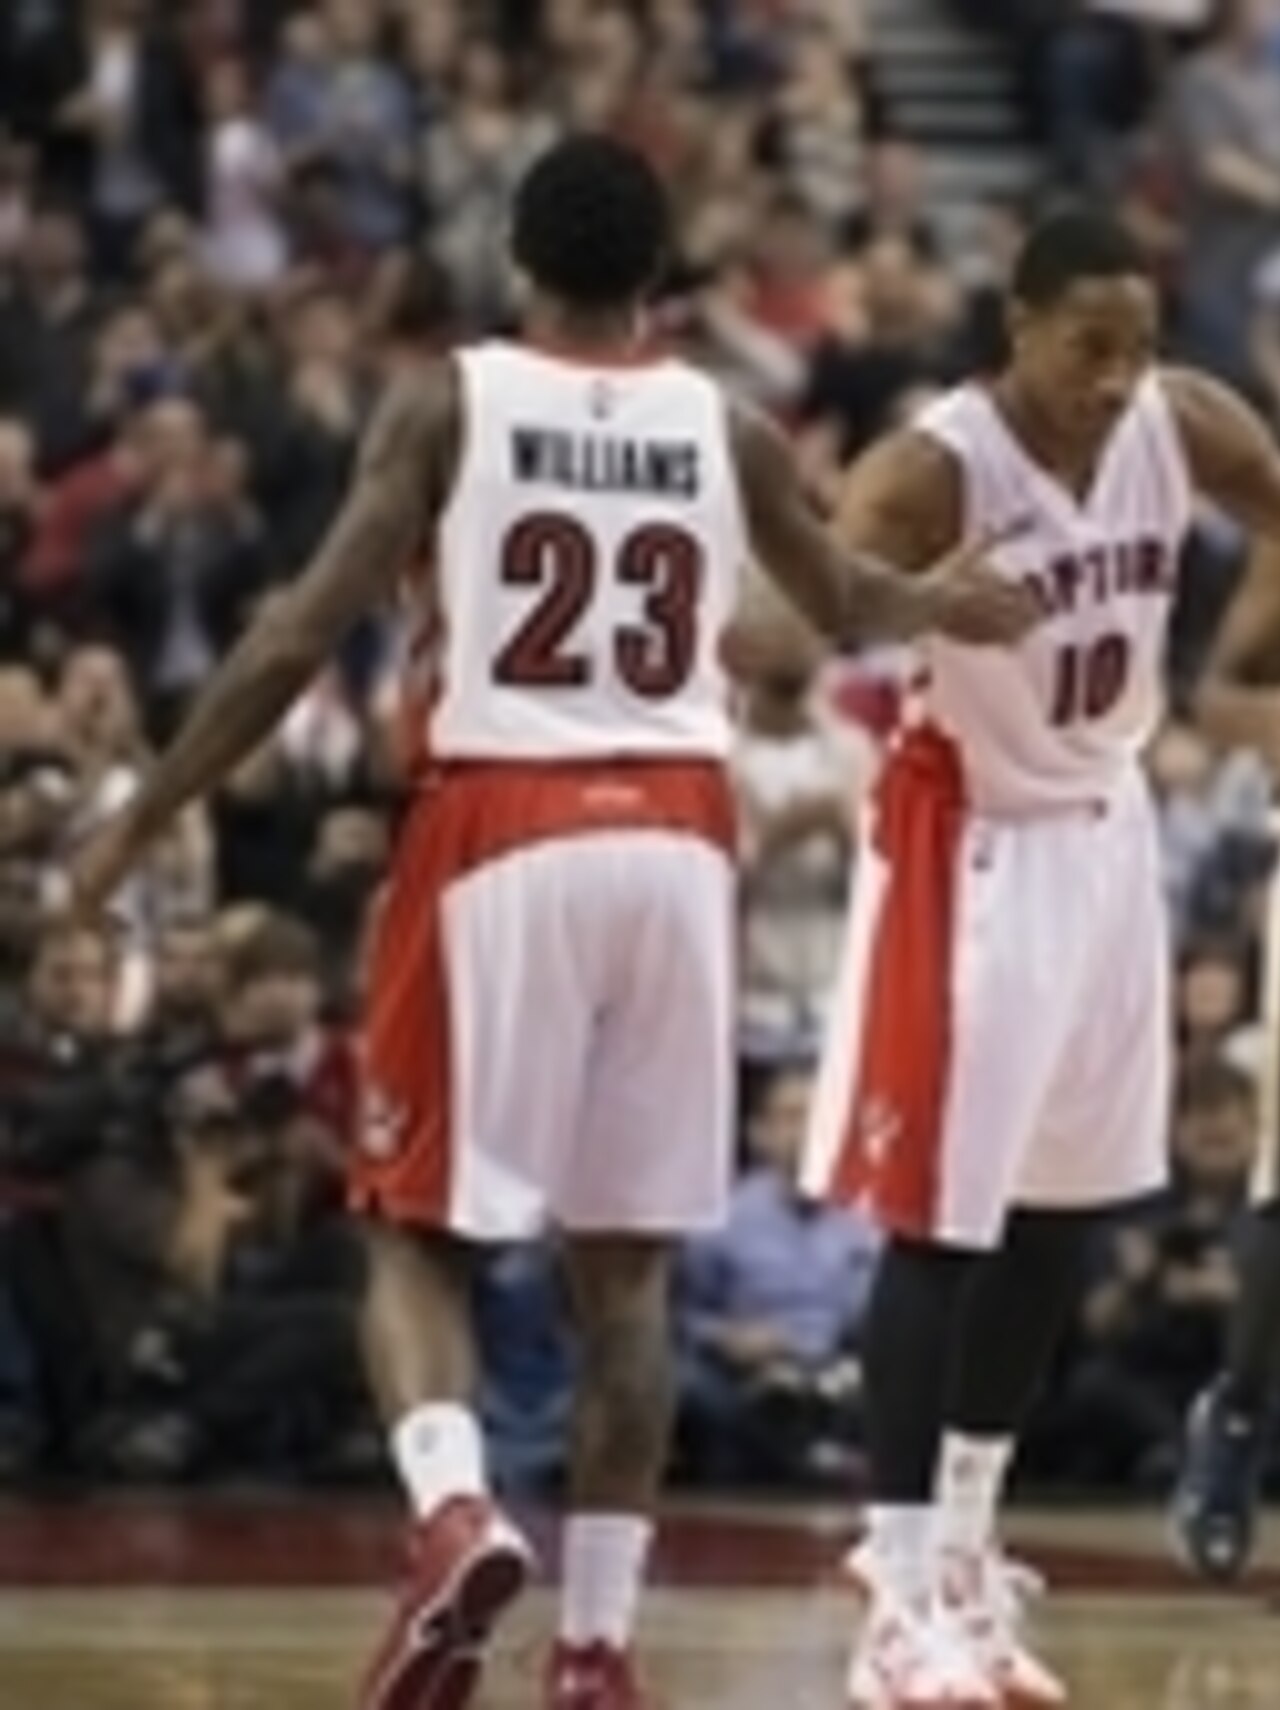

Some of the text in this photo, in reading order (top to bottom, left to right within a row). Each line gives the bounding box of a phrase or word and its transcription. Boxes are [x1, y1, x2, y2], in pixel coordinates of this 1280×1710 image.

[511, 427, 701, 501] WILLIAMS
[492, 509, 706, 701] 23
[1049, 632, 1131, 729] 10
